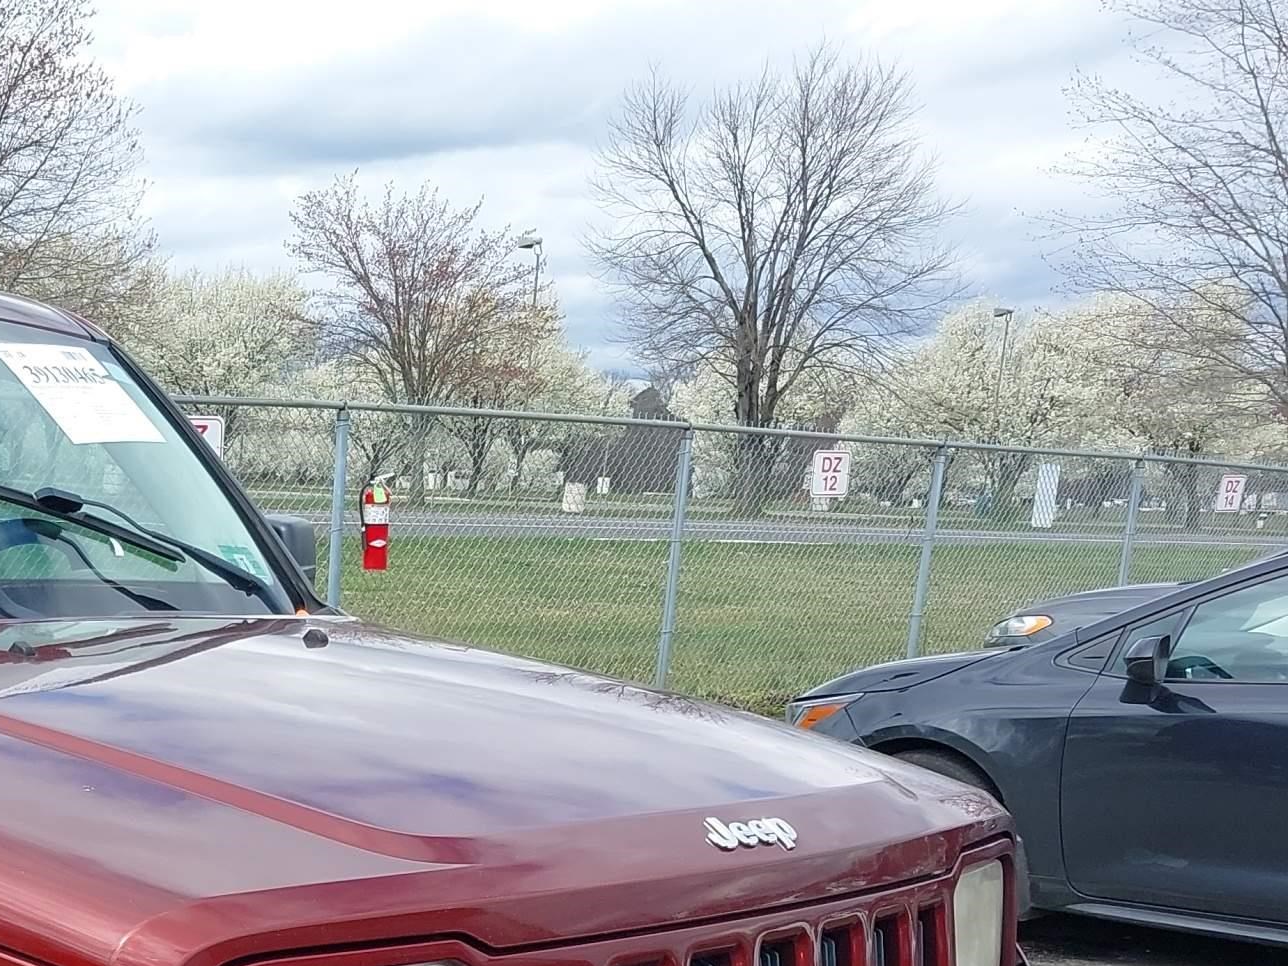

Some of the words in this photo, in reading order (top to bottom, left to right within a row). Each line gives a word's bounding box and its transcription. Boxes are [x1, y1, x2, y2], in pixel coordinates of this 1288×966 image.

[821, 456, 843, 473] DZ
[822, 475, 839, 491] 12
[1224, 480, 1241, 493] DZ
[1224, 495, 1235, 508] 14
[703, 816, 798, 851] Jeep
